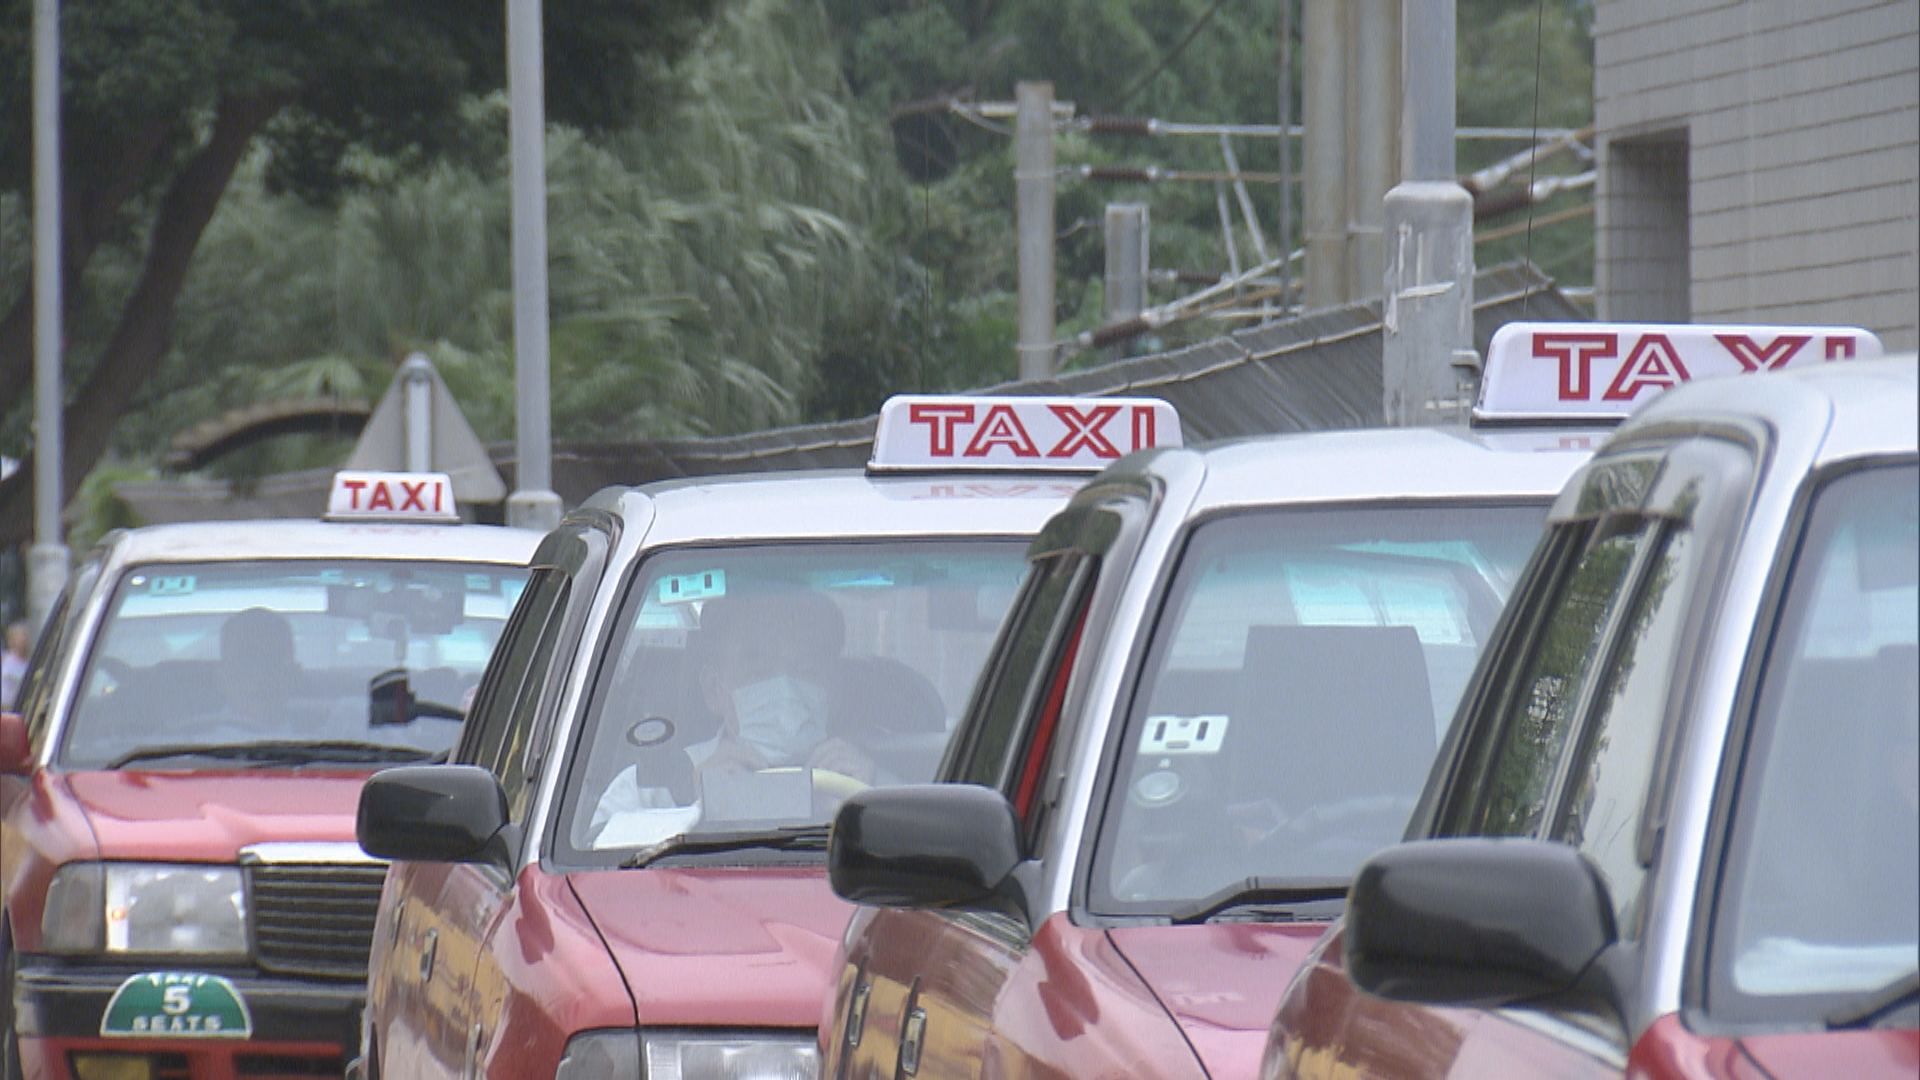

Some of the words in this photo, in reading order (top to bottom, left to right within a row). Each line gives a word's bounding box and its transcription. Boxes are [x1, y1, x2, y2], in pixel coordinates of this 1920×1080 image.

[909, 404, 1155, 458] TAXI
[343, 480, 443, 512] TAXI
[162, 986, 192, 1015] 5
[132, 1016, 222, 1031] SEATS
